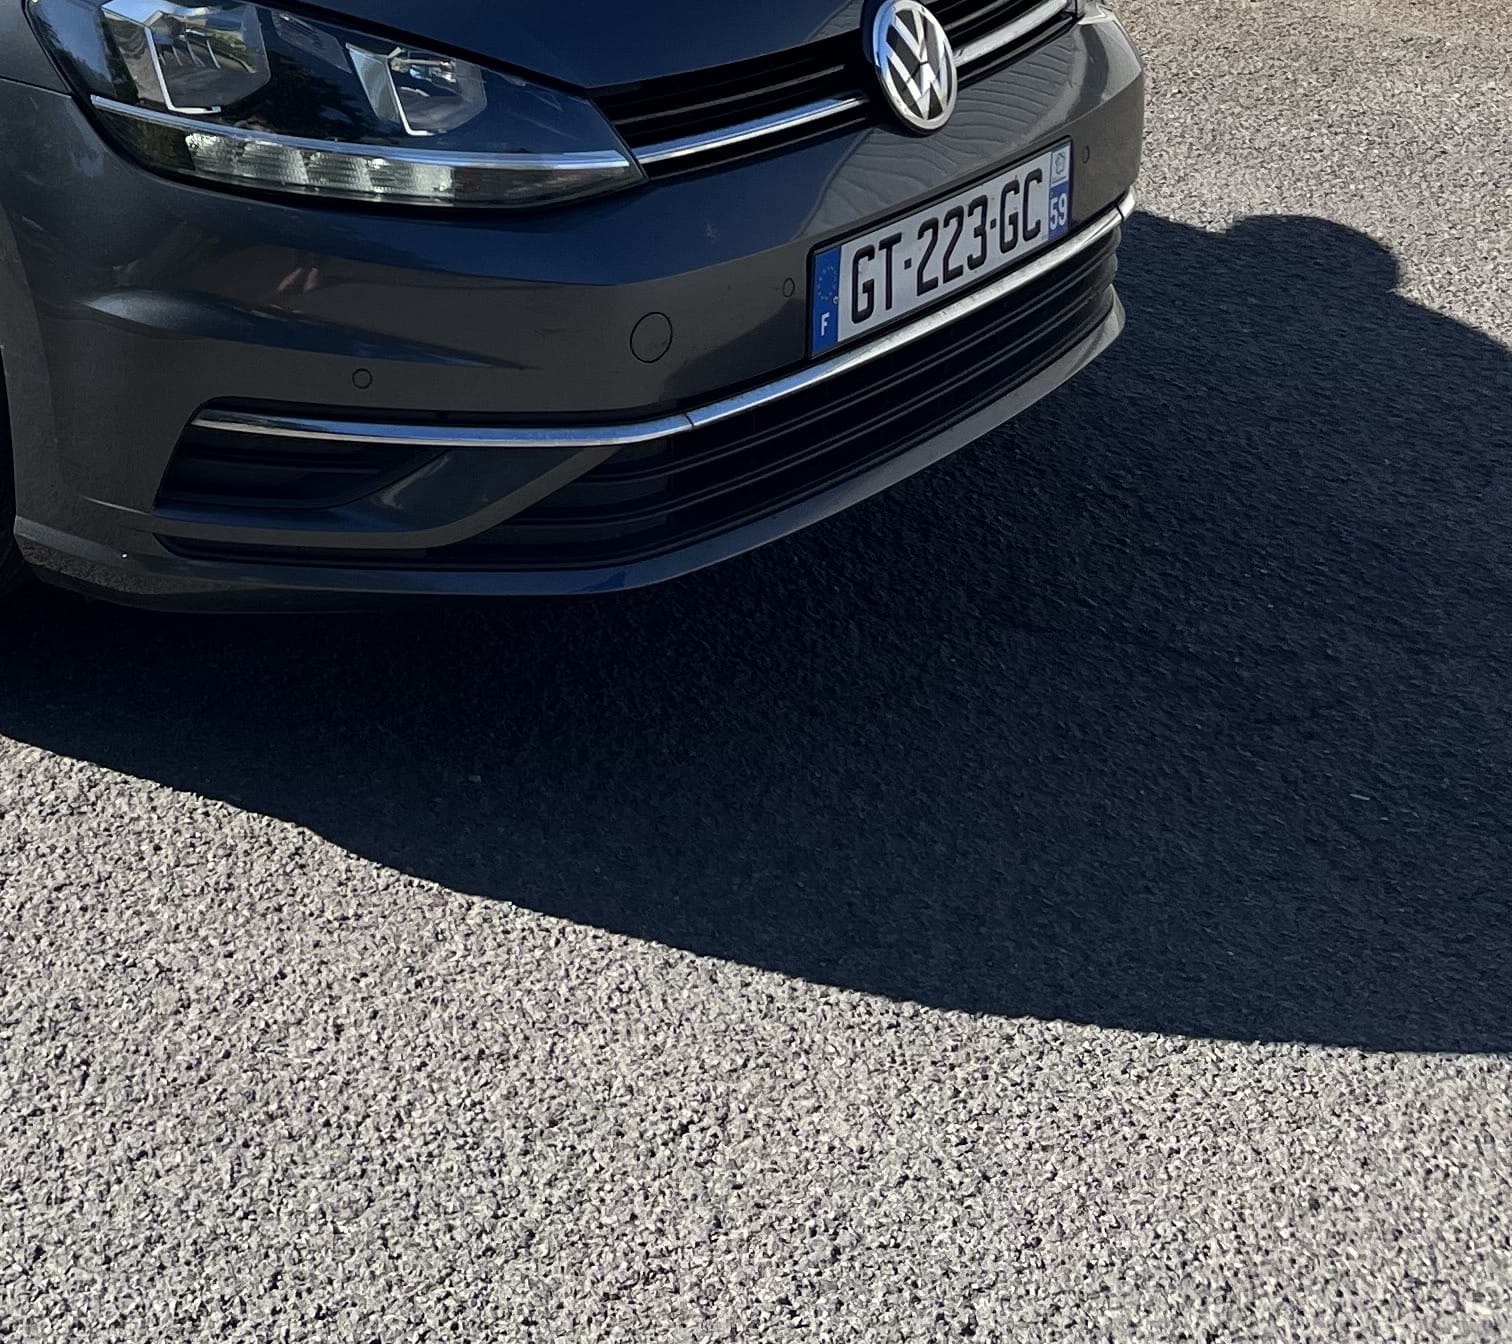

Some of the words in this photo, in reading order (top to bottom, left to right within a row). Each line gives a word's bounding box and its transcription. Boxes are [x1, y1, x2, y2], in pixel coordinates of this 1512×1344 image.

[820, 311, 830, 337] F
[850, 167, 1043, 325] GT-223-GC
[1049, 192, 1068, 230] 59
